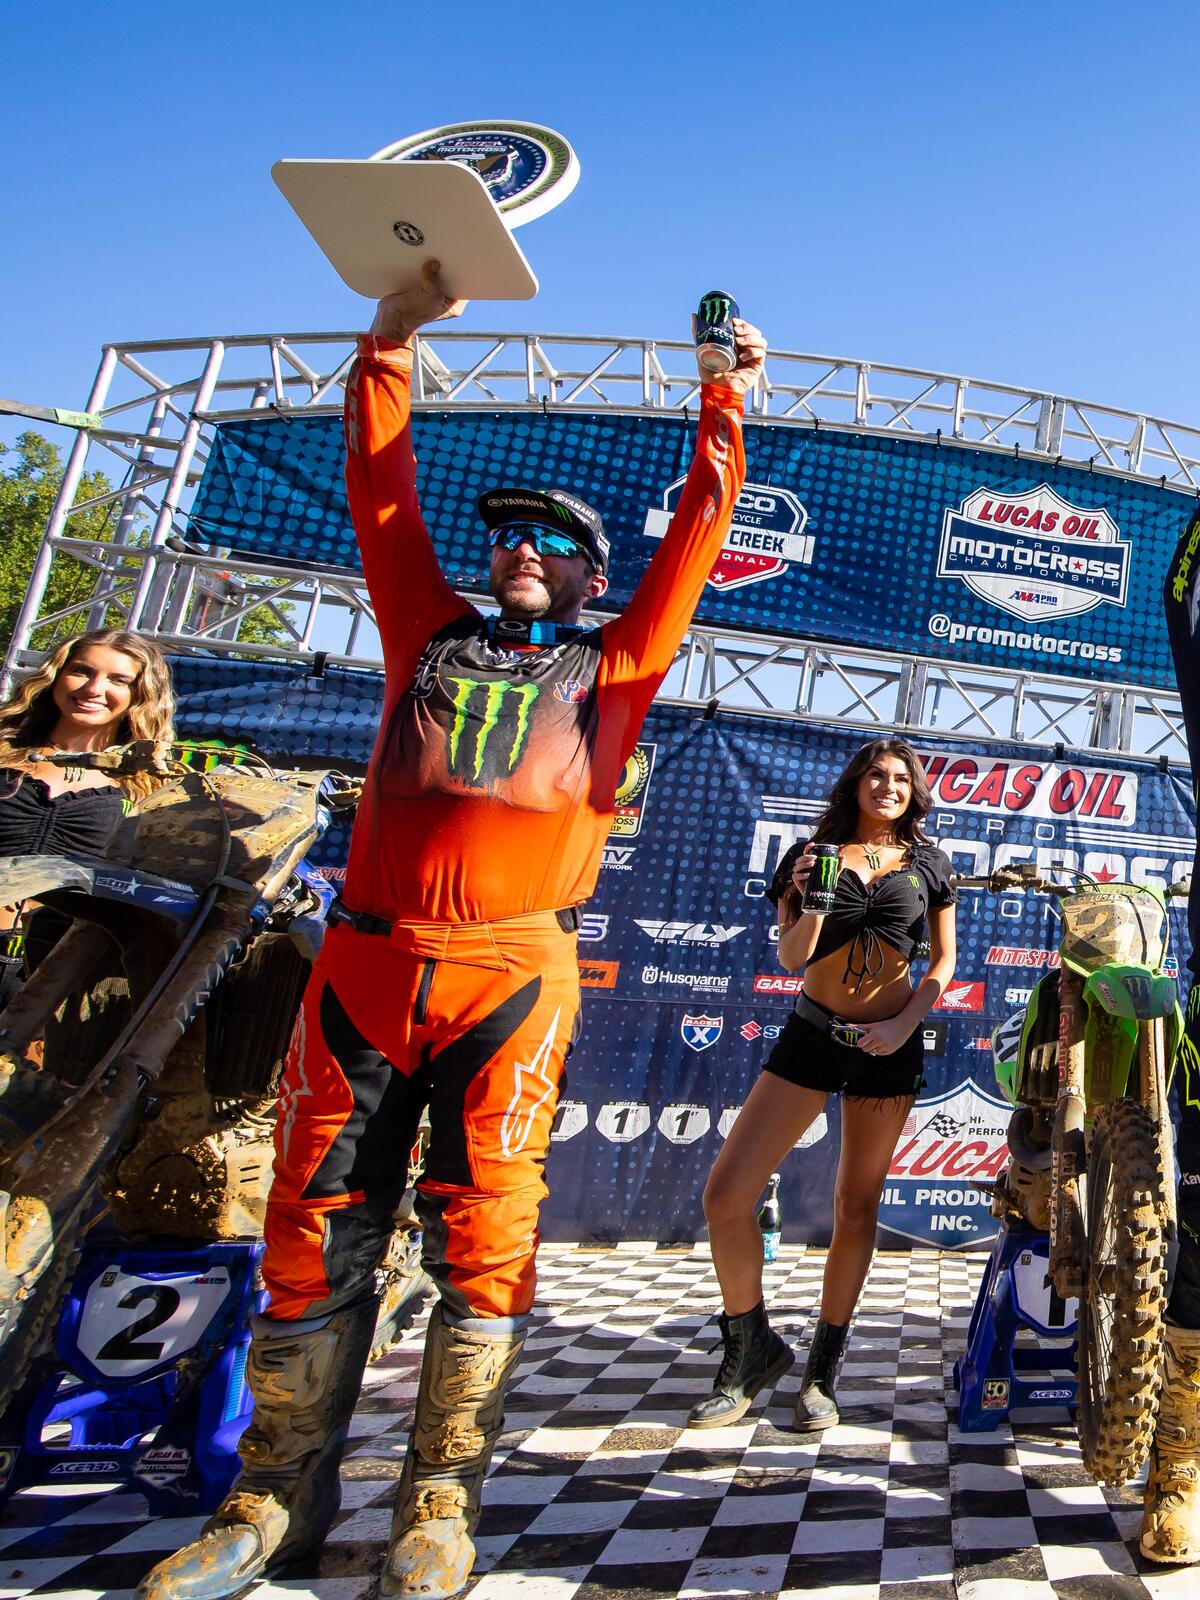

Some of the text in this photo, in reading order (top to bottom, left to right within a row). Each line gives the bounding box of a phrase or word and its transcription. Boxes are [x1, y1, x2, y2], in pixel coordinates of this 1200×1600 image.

[502, 499, 546, 509] YAMAHA
[564, 498, 596, 521] YAMAHA
[732, 514, 762, 525] CYCLE
[977, 500, 1100, 540] LUCAS OIL
[729, 529, 785, 553] CREEK
[1016, 539, 1061, 554] PRO
[721, 552, 767, 566] ONAL
[951, 536, 1121, 581] MOTOCROSS
[949, 554, 1120, 588] CHAMPIONSHIP
[1008, 591, 1058, 605] AMA PRO
[928, 613, 1123, 662] @promotocross
[554, 680, 581, 703] VP
[918, 755, 1128, 820] UCAS OIL
[936, 814, 1055, 841] PRO
[654, 938, 720, 948] RACING
[659, 970, 729, 987] Husqvarna
[942, 1001, 972, 1009] HONDA
[691, 1028, 709, 1044] X
[888, 1139, 1010, 1178] LUCA
[880, 1188, 992, 1206] IL PRODU
[1050, 1150, 1060, 1247] DUNLOP
[930, 1215, 979, 1232] INC.
[95, 1284, 181, 1360] 2
[986, 1380, 1008, 1395] 50
[1029, 1390, 1073, 1399] ACERBIS
[150, 1450, 171, 1459] LUCAS
[50, 1462, 119, 1473] ACERBIS
